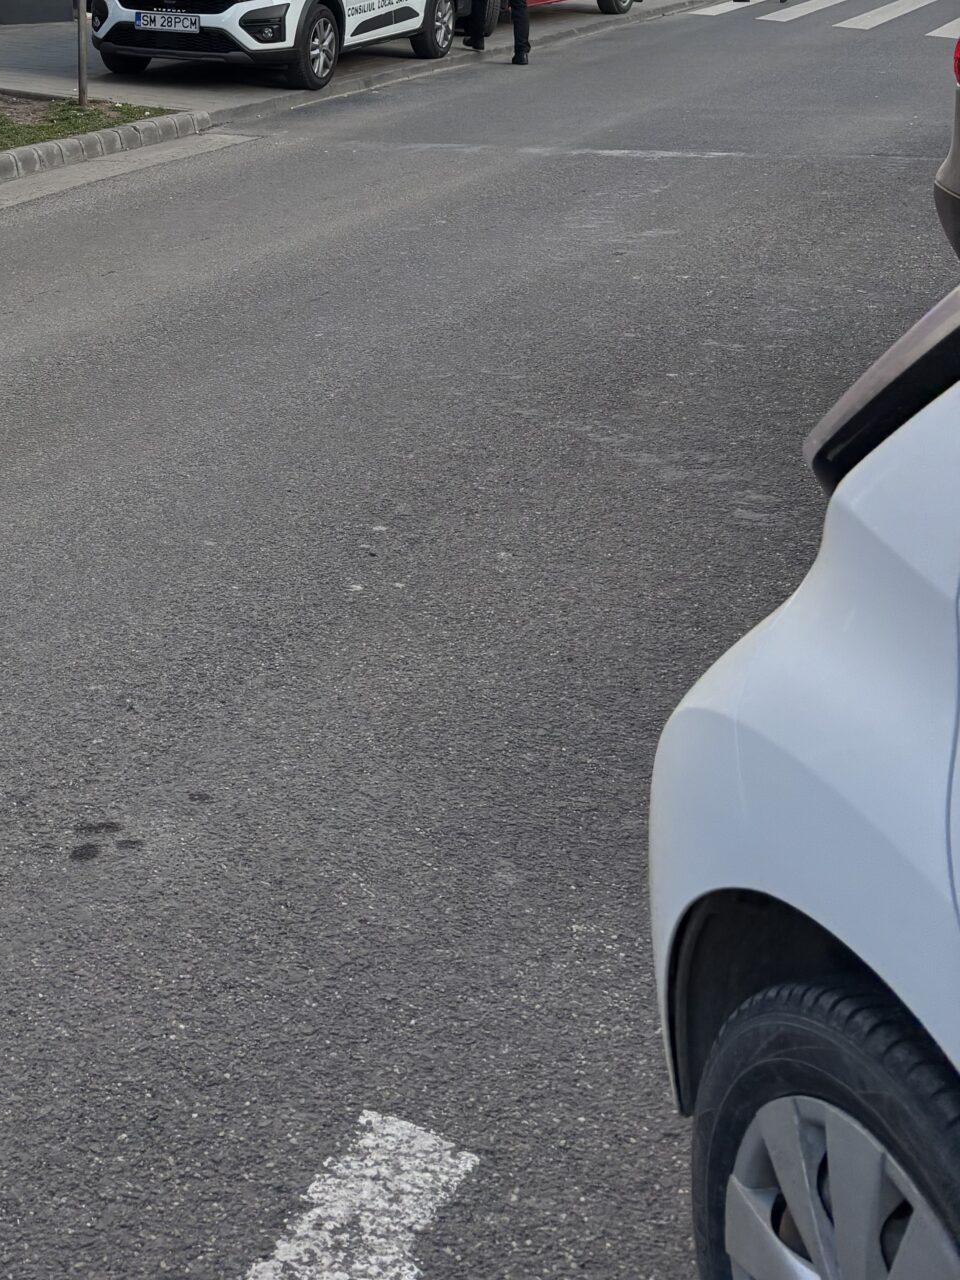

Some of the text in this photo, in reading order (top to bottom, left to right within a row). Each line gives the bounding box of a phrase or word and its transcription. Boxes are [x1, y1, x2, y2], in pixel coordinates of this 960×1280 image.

[347, 2, 376, 17] CONSILIUL
[377, 0, 394, 10] LOCAL
[141, 14, 157, 27] SM
